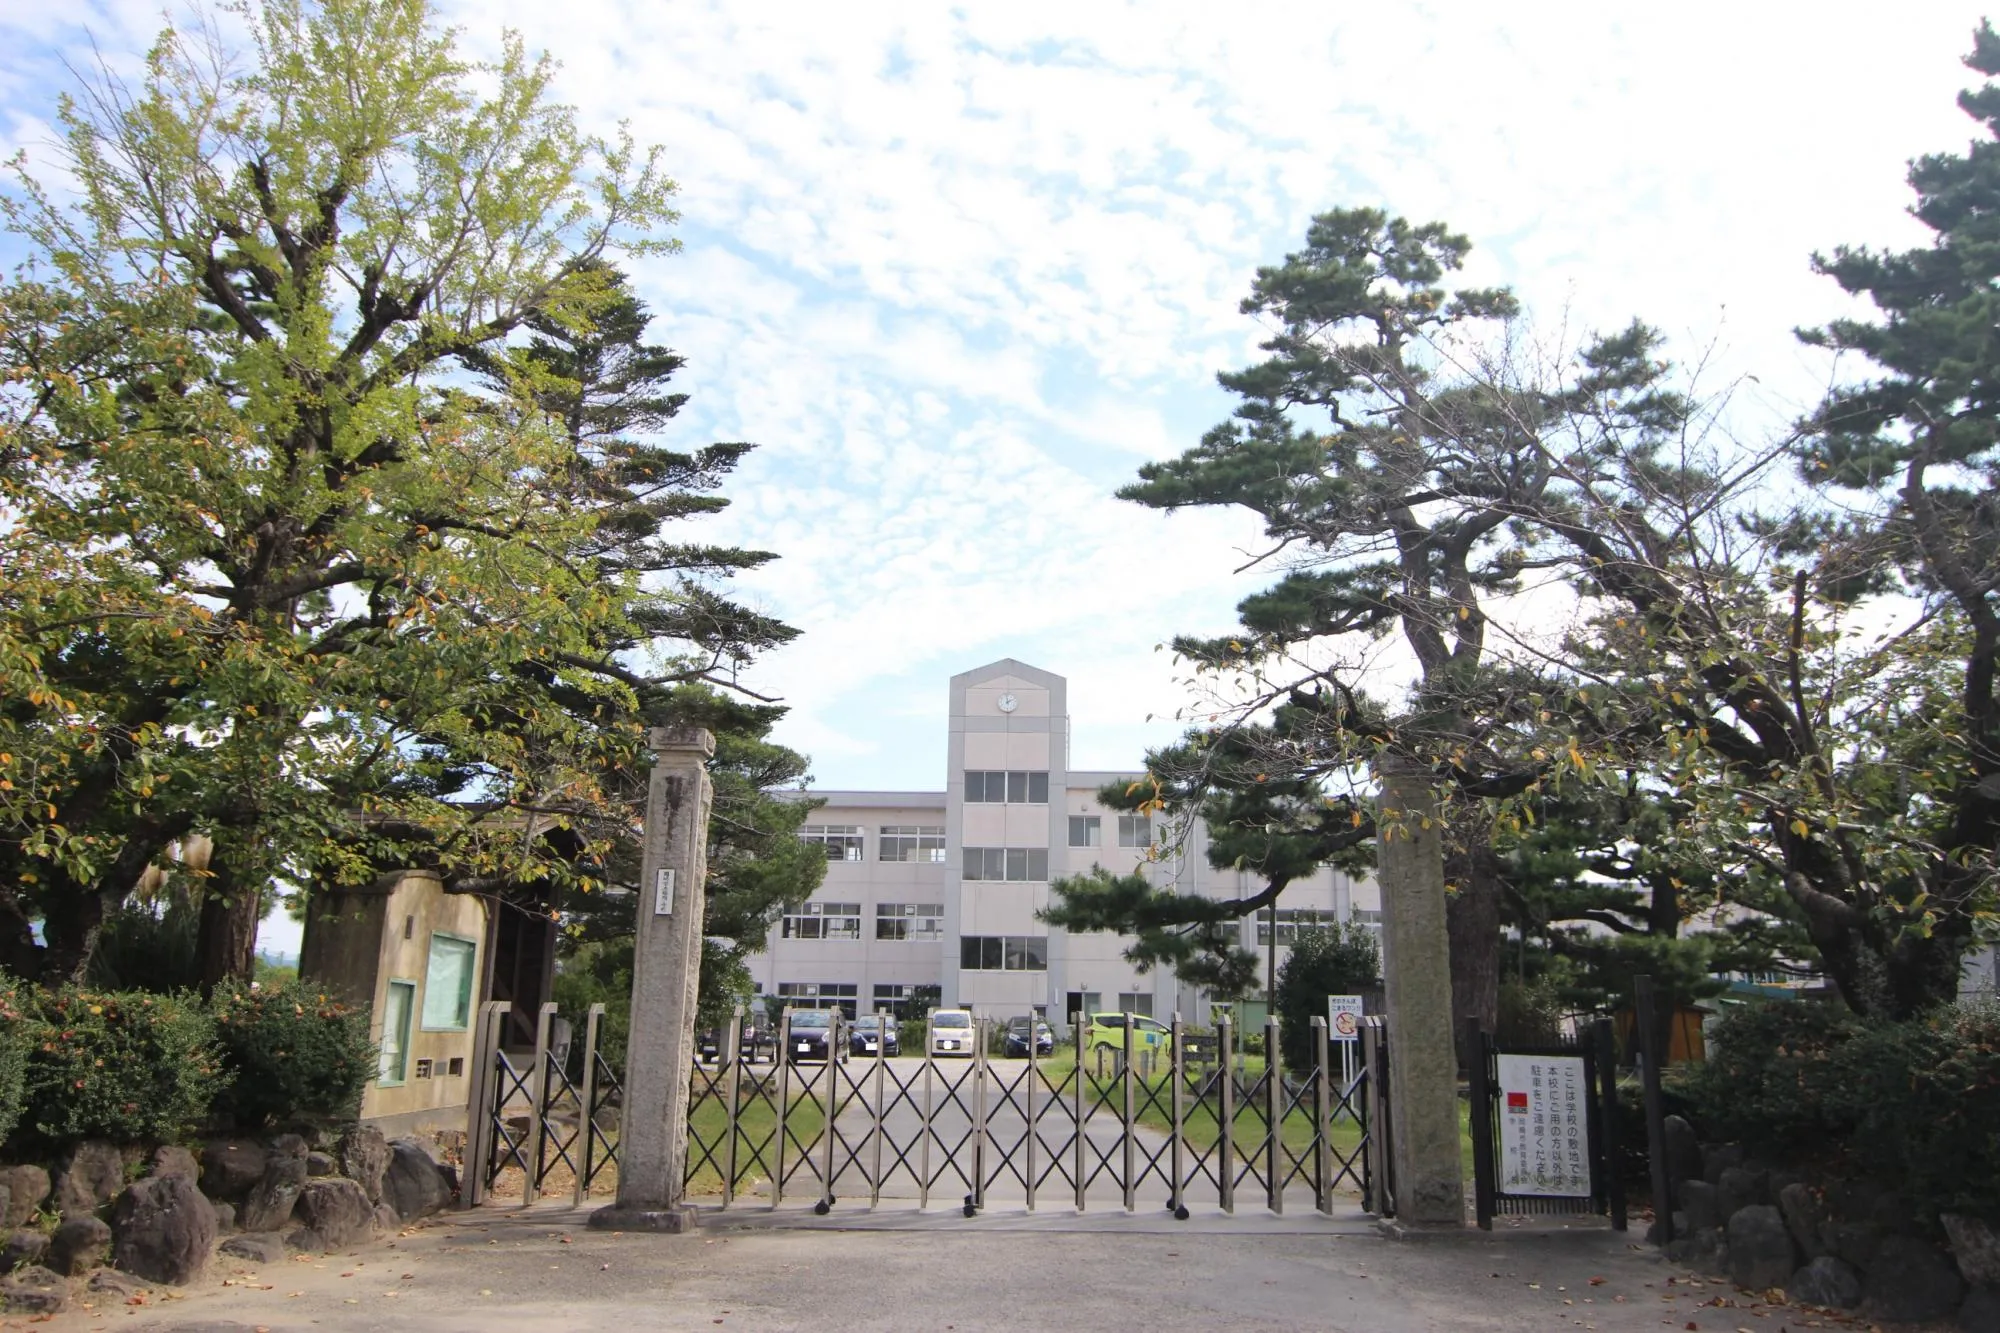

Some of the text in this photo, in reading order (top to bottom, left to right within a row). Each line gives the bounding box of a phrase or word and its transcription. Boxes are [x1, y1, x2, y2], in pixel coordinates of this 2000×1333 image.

[1531, 1065, 1546, 1186] 駐車をご遠慮ください
[1547, 1066, 1563, 1186] 本校にご用の方以外は
[1564, 1067, 1579, 1186] ここは学校の敷地です
